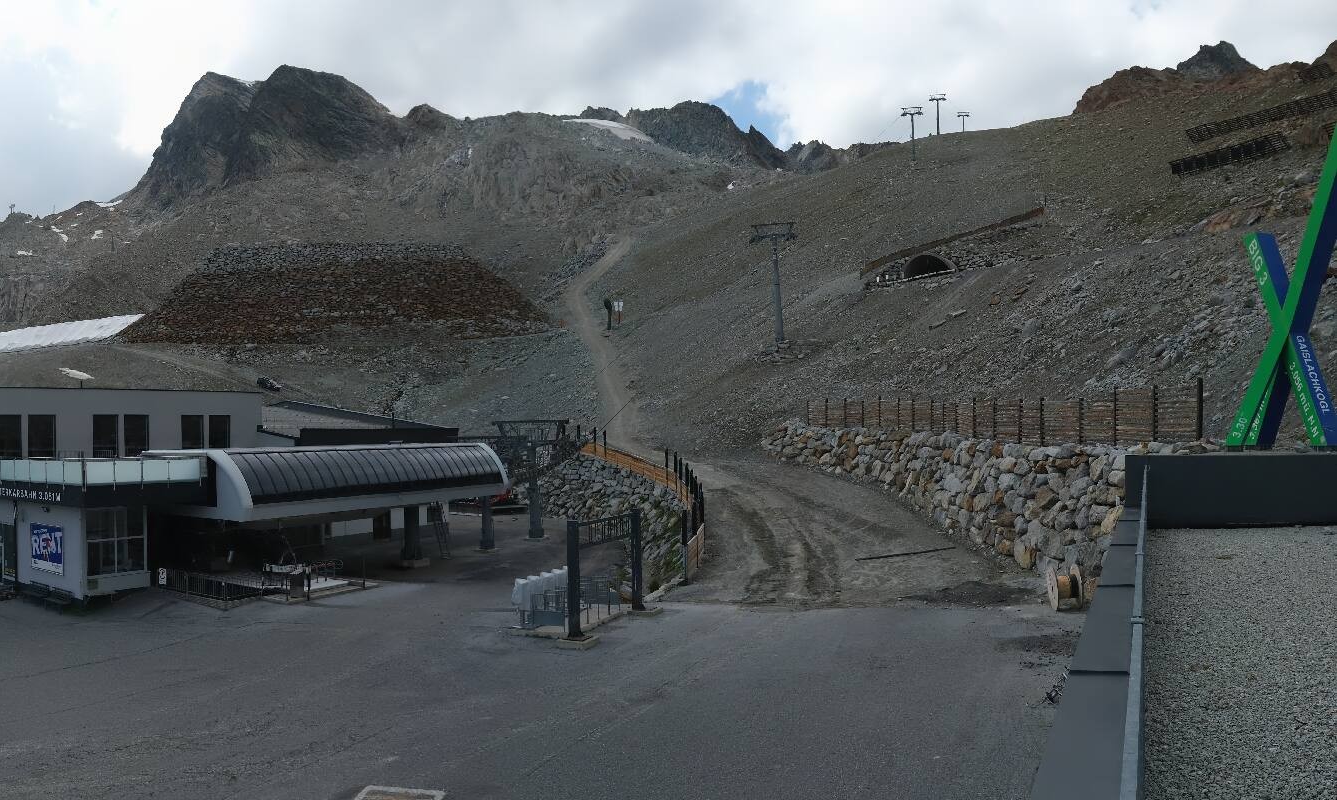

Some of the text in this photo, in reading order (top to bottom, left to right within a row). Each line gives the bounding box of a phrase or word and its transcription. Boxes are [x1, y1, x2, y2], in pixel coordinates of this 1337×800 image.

[1248, 238, 1268, 286] BIG 3
[1296, 335, 1330, 414] GAISLACHKOGL
[31, 532, 62, 556] RENT
